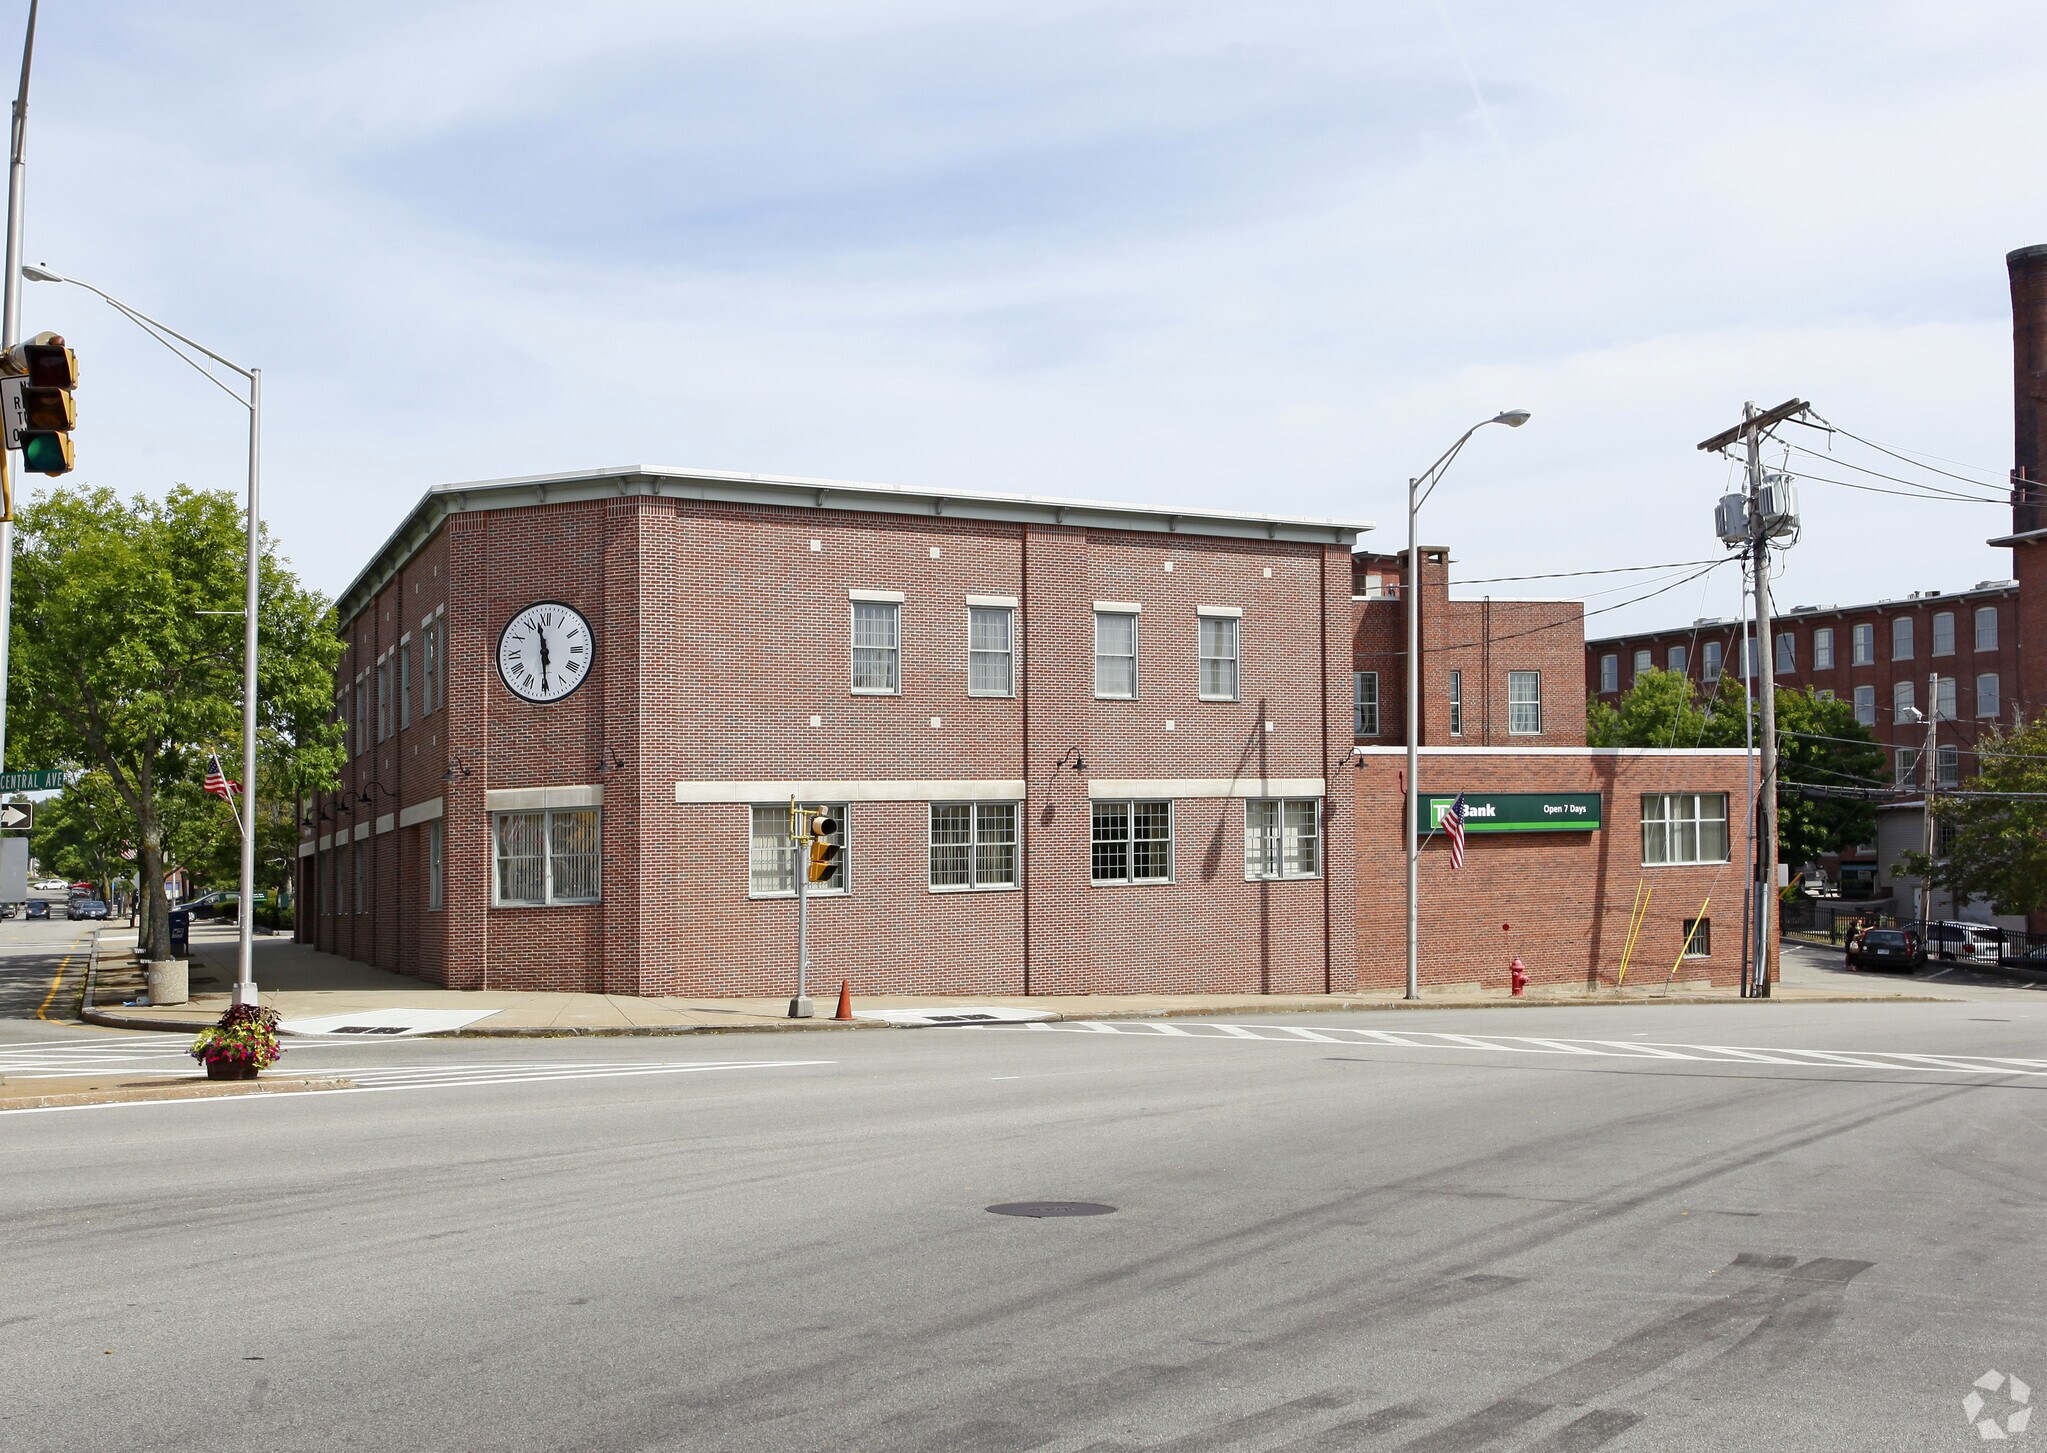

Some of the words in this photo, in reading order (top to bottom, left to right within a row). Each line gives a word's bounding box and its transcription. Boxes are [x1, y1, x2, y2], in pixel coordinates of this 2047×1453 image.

[523, 617, 536, 633] XI
[540, 613, 551, 626] XII
[512, 632, 525, 643] X
[0, 774, 38, 789] CENTRAL
[46, 772, 63, 787] AVE
[1462, 803, 1496, 817] Bank
[1543, 804, 1563, 815] Open
[1563, 804, 1569, 813] 7
[1569, 804, 1587, 815] Days
